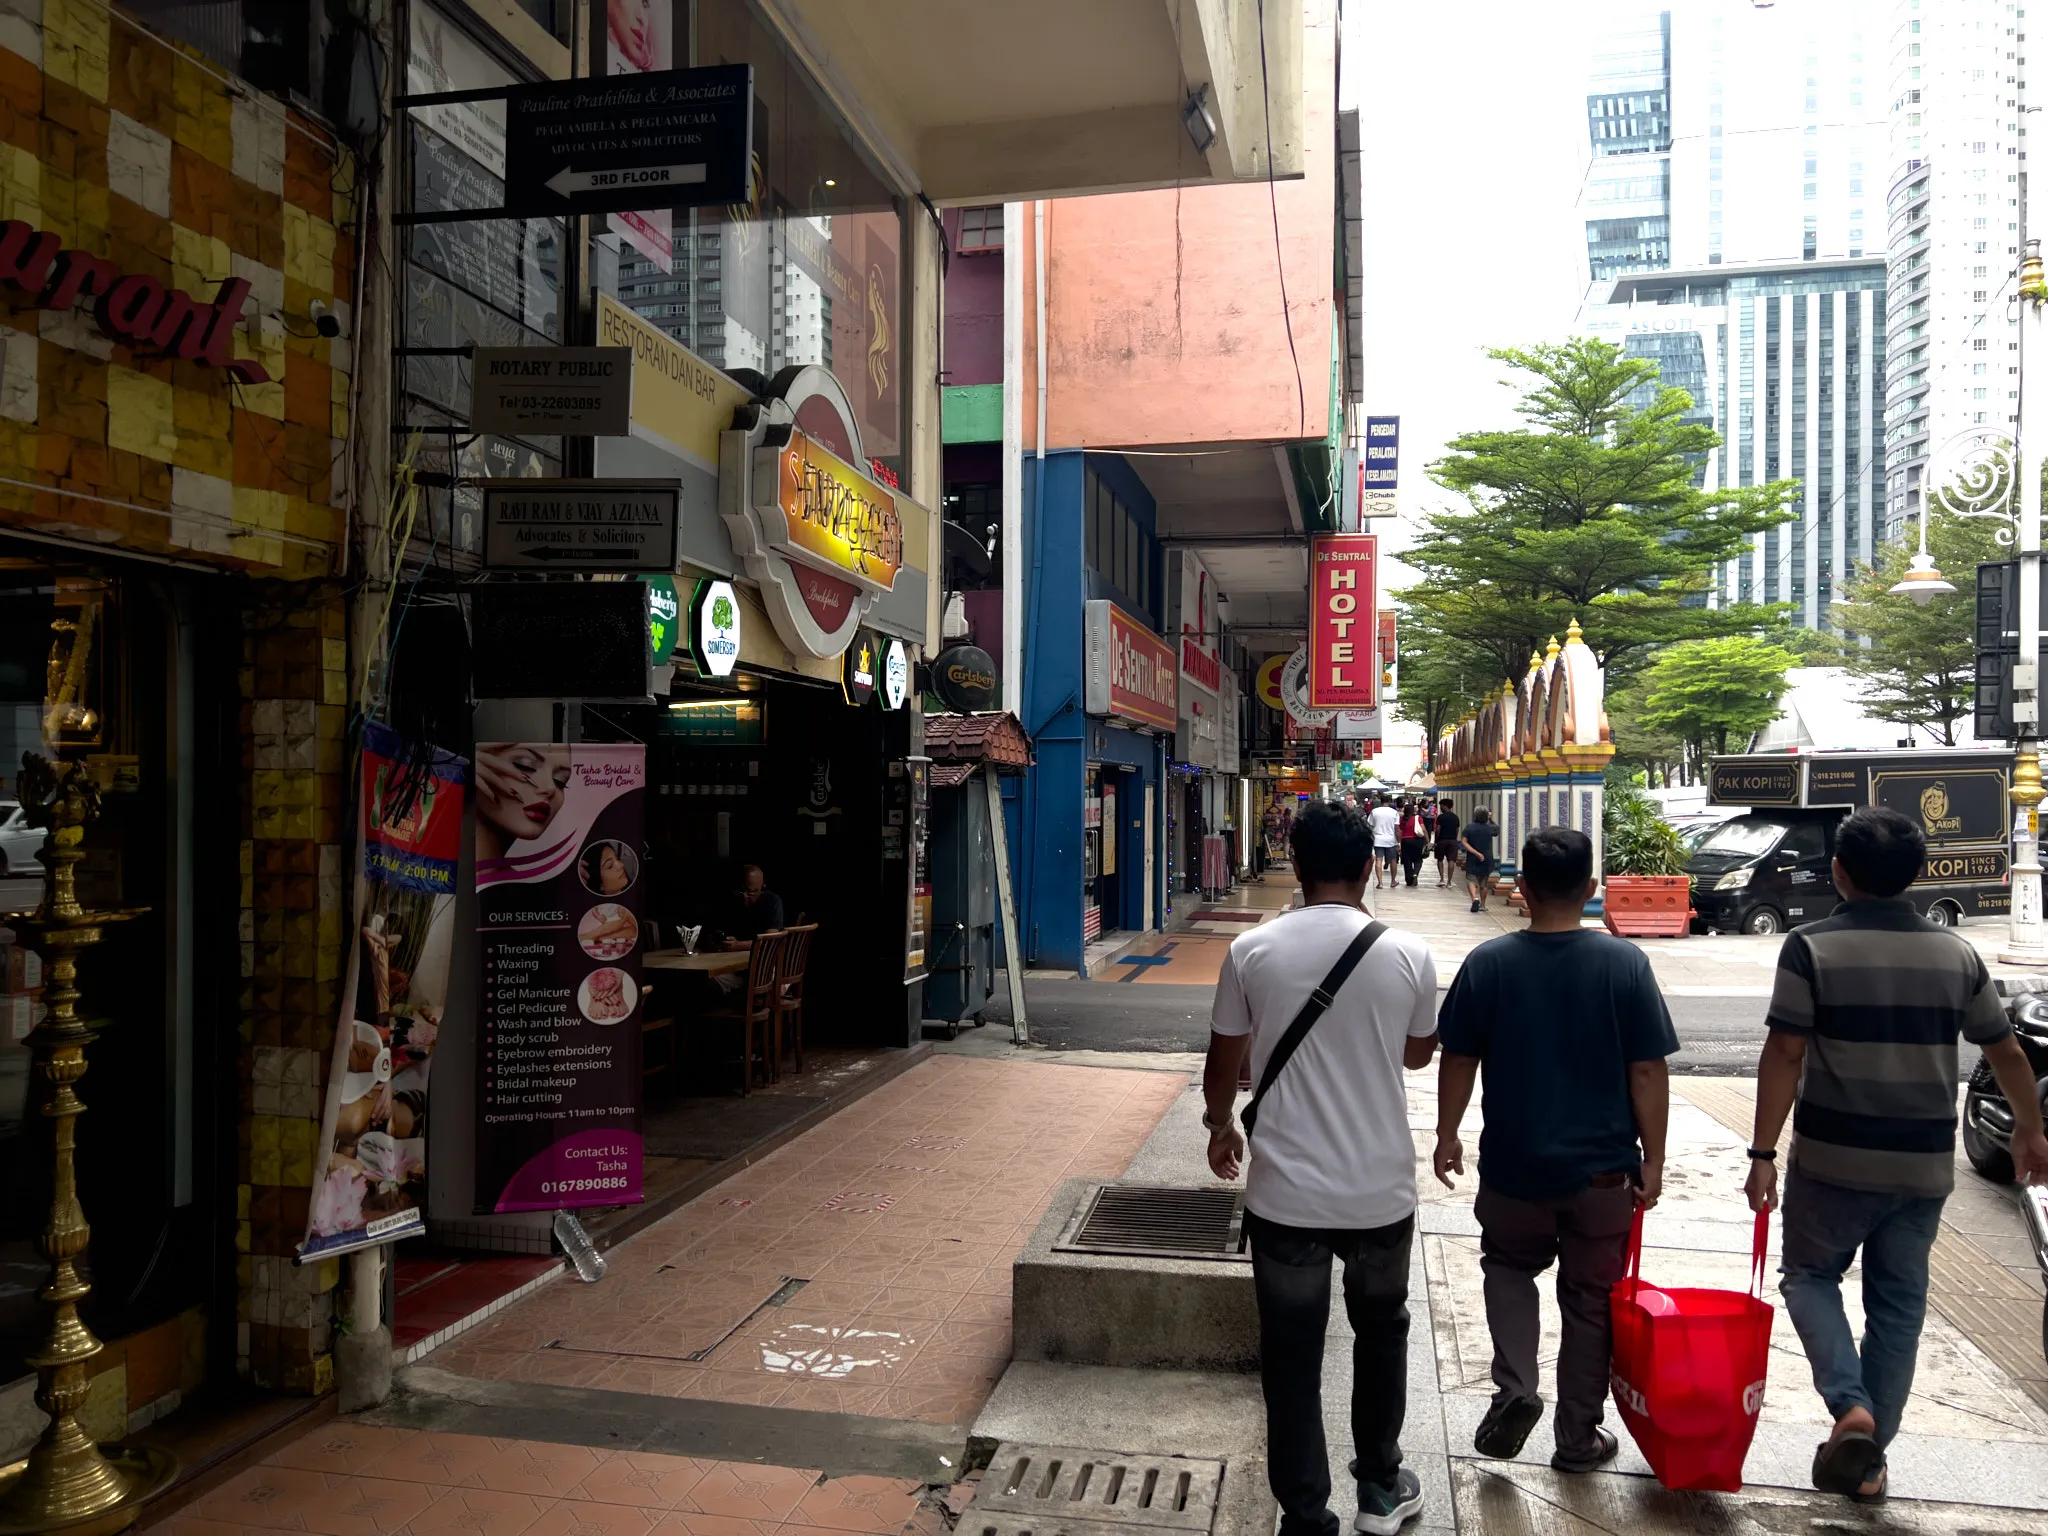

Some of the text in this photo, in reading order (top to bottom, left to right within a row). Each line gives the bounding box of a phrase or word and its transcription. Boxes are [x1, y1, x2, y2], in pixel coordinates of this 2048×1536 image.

[519, 83, 737, 113] Pauline Prathibha & Associates
[535, 120, 616, 137] PEGUAMBELA
[550, 139, 617, 155] ADVOCATES
[631, 132, 702, 149] SOLICITORS
[591, 170, 670, 186] 3RD FLOOR
[603, 307, 716, 405] RESTORAN DAN BAR
[489, 361, 614, 377] NOTARY PUBLIC
[1370, 424, 1396, 436] PENGEDAR
[1368, 447, 1397, 459] PERALATAN
[1366, 469, 1397, 482] KESELAMATAN
[1373, 491, 1396, 499] Chubb
[532, 502, 560, 520] RAM
[565, 502, 573, 520] &
[515, 528, 646, 544] Advocates & Solicitors
[1318, 551, 1371, 562] DE SENTRAL
[1329, 569, 1357, 687] HOTEL
[707, 639, 736, 656] SOMERSBY
[1112, 623, 1123, 689] DE
[1124, 632, 1156, 703] SENTRAL
[1156, 652, 1175, 709] HOTEL
[947, 664, 996, 691] Carlsberg
[1344, 710, 1373, 718] SAFARI
[573, 763, 642, 776] Tasha Bridal &
[583, 775, 635, 788] Beauty Care
[1718, 776, 1772, 789] PAK KOPI
[1927, 859, 1969, 876] KOPI
[1971, 857, 1996, 865] SINCE
[405, 864, 427, 879] 2:00
[430, 867, 449, 882] PM
[1972, 865, 1996, 874] 1969
[1978, 900, 1990, 908] 018
[1991, 899, 2002, 907] 218
[489, 911, 513, 922] OUR
[497, 944, 554, 955] Threading
[497, 958, 539, 970] Waxing
[497, 973, 529, 985] Facial
[497, 987, 571, 999] Gel Manicure
[497, 1002, 567, 1015] Gel Pedicure
[497, 1016, 582, 1030] Wash and blow
[497, 1032, 559, 1046] Body scrub
[497, 1044, 612, 1061] Eyebrow embroidery
[497, 1060, 612, 1076] Eyelashes extensions
[497, 1076, 577, 1089] Bridal makeup
[497, 1092, 562, 1105] Hair cutting
[485, 1106, 635, 1124] Operating Hours: 11am to 10pm
[565, 1145, 628, 1159] Contact Us:
[597, 1161, 628, 1172] Tasha
[541, 1177, 628, 1193] 0167890886
